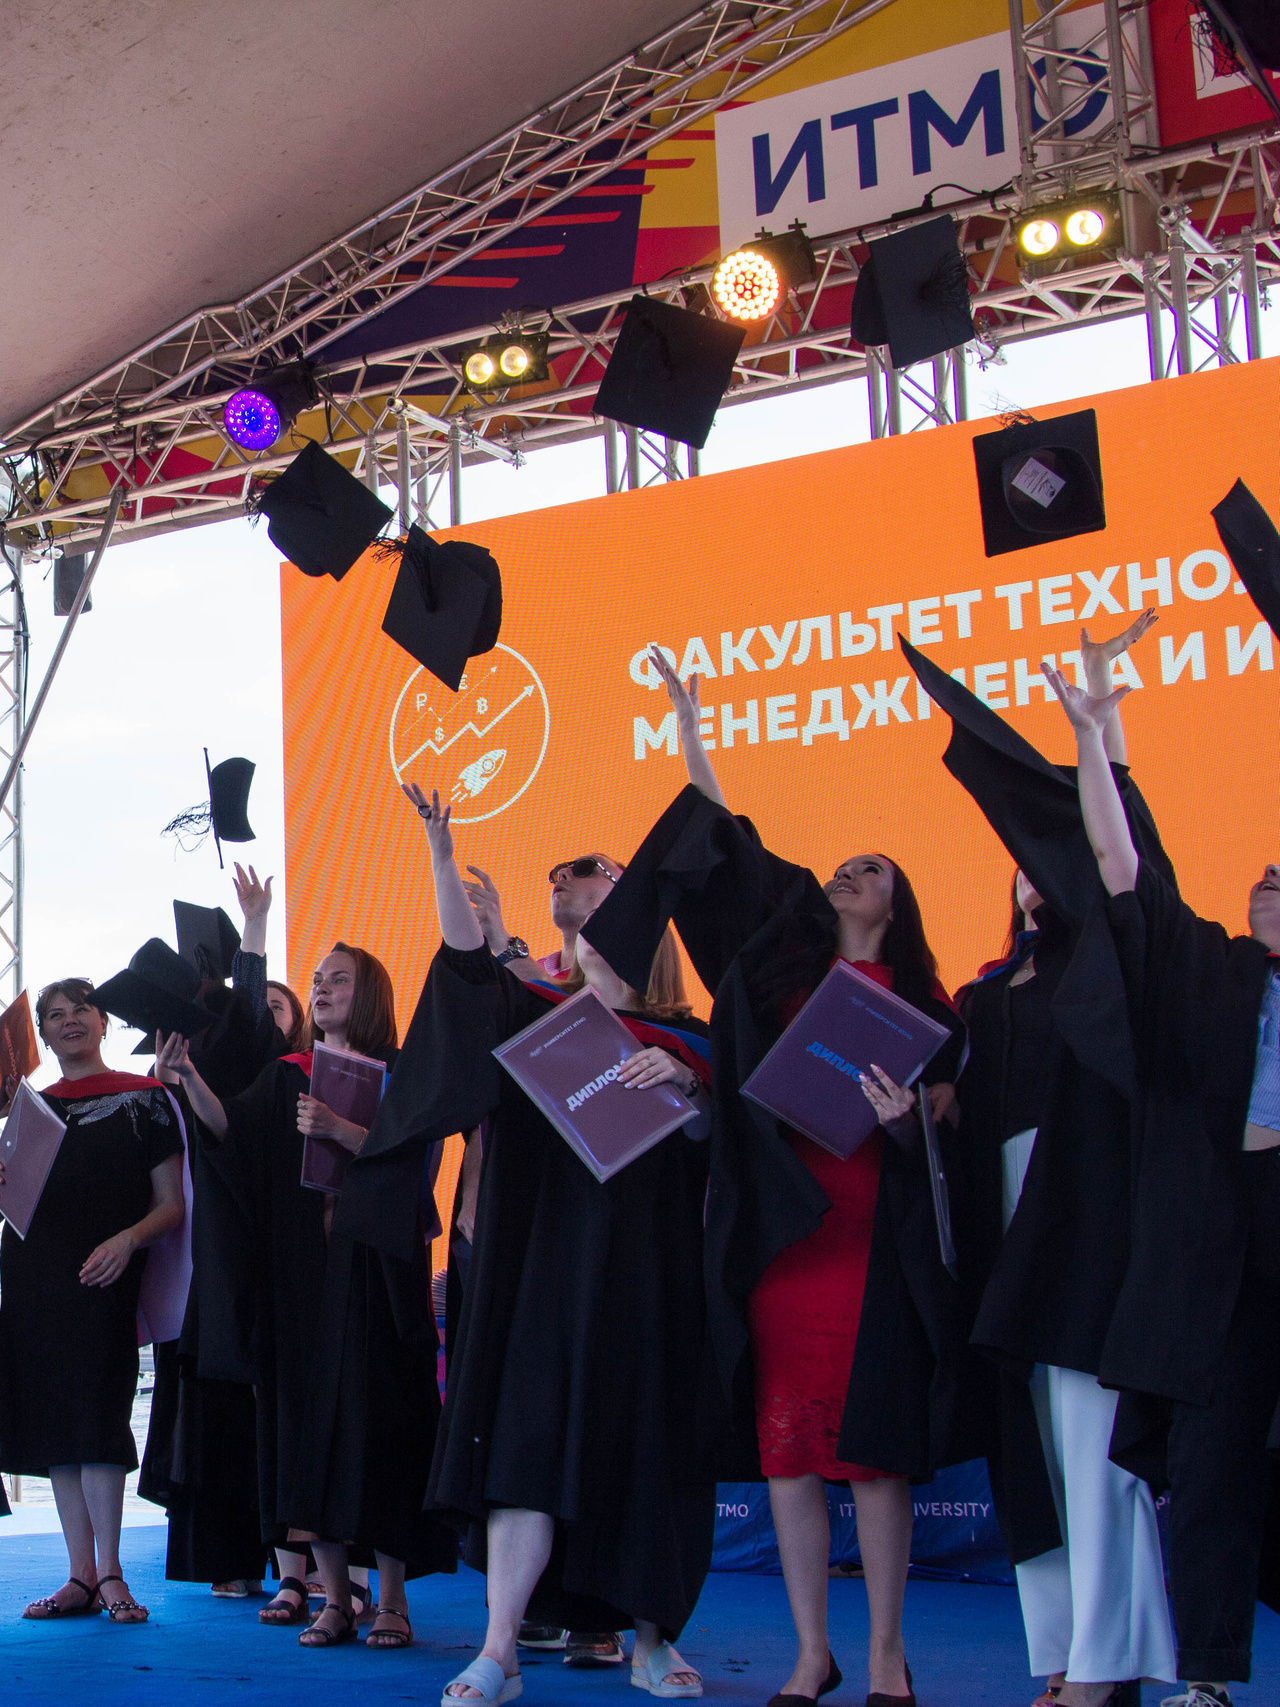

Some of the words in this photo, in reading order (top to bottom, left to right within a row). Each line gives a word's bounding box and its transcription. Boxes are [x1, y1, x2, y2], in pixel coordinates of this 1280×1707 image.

[629, 589, 982, 690] ФАКУЛЬТЕТ
[995, 549, 1247, 631] ТЕХНО
[1159, 631, 1207, 686] И
[1225, 620, 1274, 676] И
[805, 1041, 879, 1085] ДИПЛО
[716, 1503, 749, 1518] TMO
[839, 1503, 856, 1517] IT
[914, 1502, 990, 1517] IVERSITY
